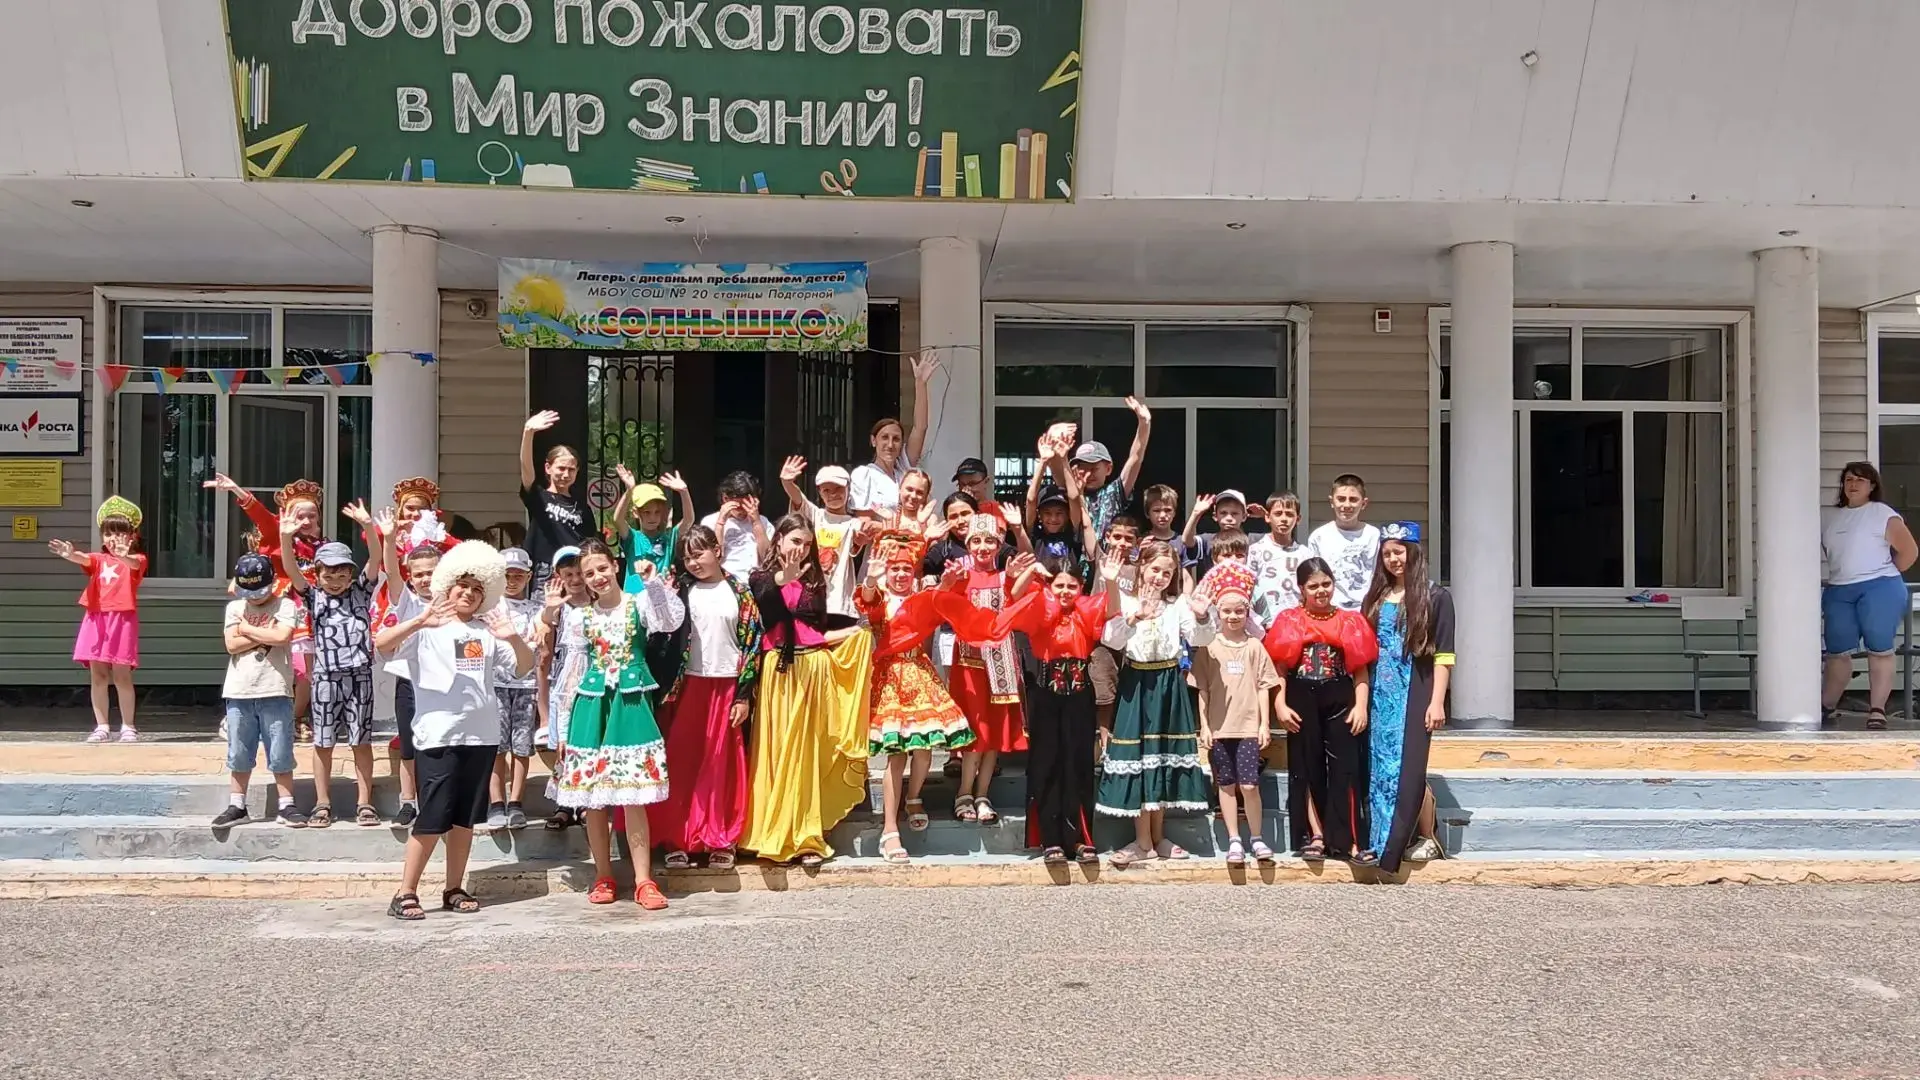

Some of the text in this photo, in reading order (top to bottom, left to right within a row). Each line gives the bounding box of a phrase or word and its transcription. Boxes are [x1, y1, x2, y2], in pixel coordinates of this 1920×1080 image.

[291, 0, 1022, 57] Добро пожаловать
[396, 72, 924, 153] в Мир Знаний!
[576, 271, 846, 286] Лагерь с дневным пребыванием детей
[587, 287, 834, 301] МБОУ СОШ № 20 станицы Подгорной
[577, 306, 847, 338] «СОЛНЫШКО»
[38, 423, 75, 432] РОСТА
